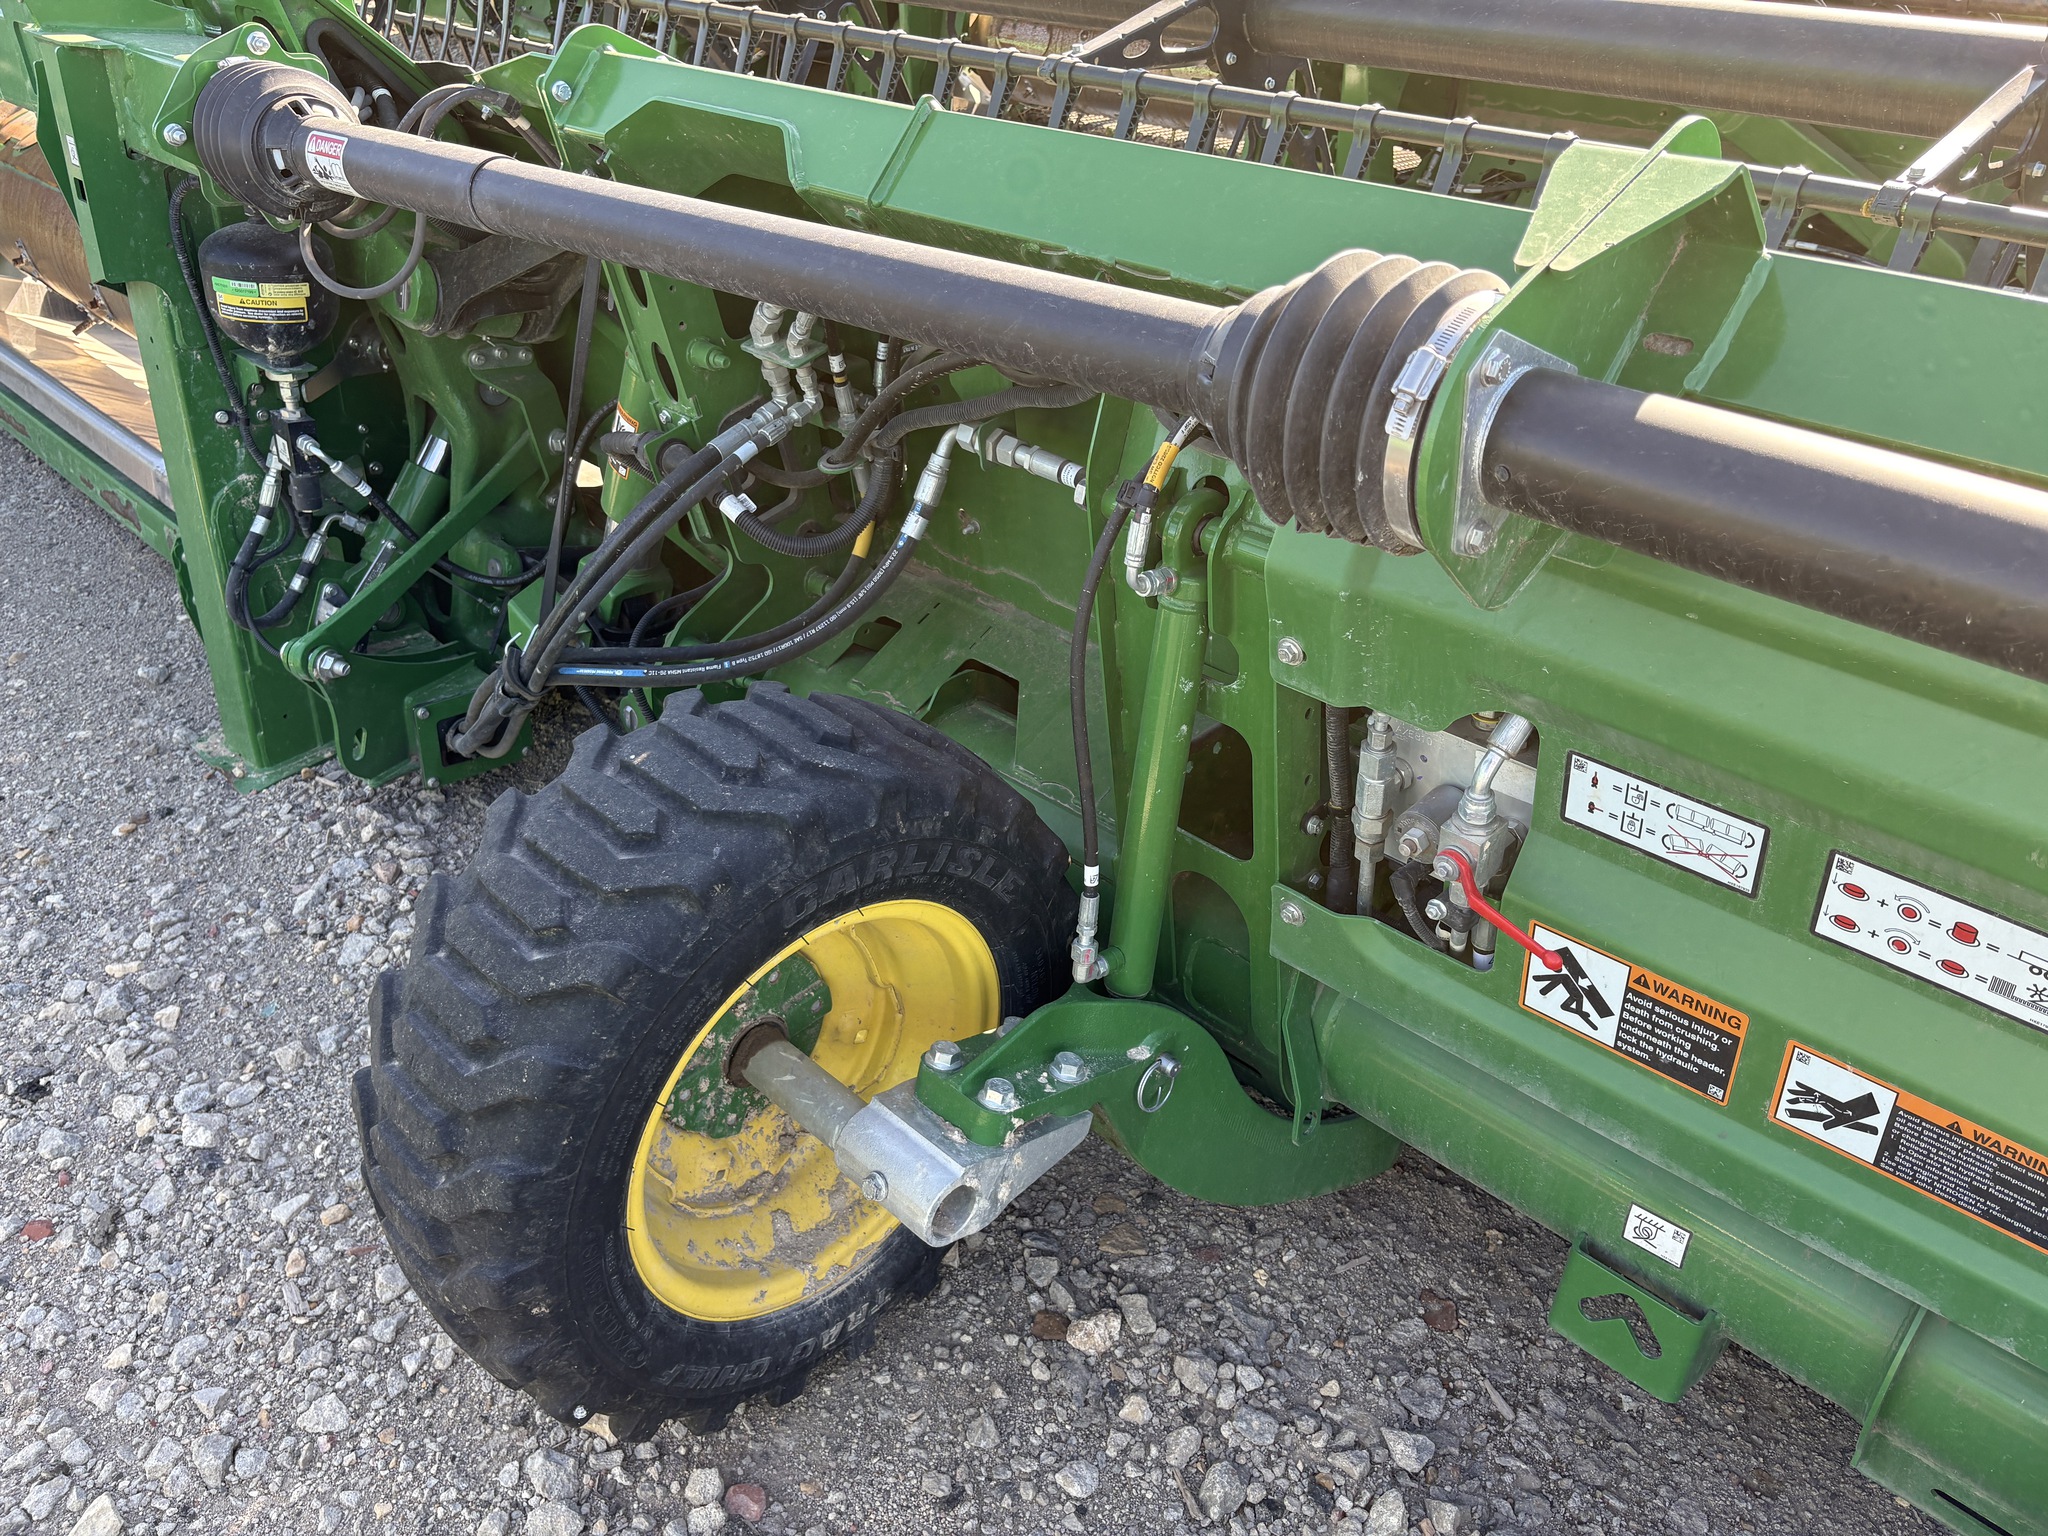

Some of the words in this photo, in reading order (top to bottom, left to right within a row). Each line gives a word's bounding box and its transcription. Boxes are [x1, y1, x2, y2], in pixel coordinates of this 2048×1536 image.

[316, 139, 343, 157] DANGER
[784, 842, 1025, 928] CARLISLE
[1622, 1011, 1652, 1031] Before
[1654, 1025, 1692, 1050] working
[1624, 1002, 1650, 1019] death
[1652, 1015, 1673, 1030] from
[1675, 1026, 1720, 1052] crushing.
[1626, 992, 1652, 1009] Avoid
[1654, 1004, 1689, 1027] serious
[1691, 1021, 1720, 1041] injury
[1721, 1036, 1732, 1046] or
[1652, 980, 1742, 1030] WARNING
[1616, 1040, 1651, 1061] system.
[1618, 1030, 1638, 1044] lock
[1640, 1040, 1654, 1052] the
[1656, 1048, 1699, 1074] hydraulic
[1620, 1022, 1672, 1050] underneath
[1674, 1046, 1689, 1058] the
[1691, 1053, 1726, 1077] header,
[1894, 1122, 1919, 1137] Before
[1920, 1135, 1956, 1156] removing
[1958, 1152, 1994, 1172] hydraulic
[1996, 1171, 2047, 1199] components.
[1896, 1116, 1906, 1124] oil
[1907, 1120, 1922, 1132] and
[1923, 1128, 1938, 1139] gas
[1939, 1136, 1962, 1150] under
[1963, 1148, 2000, 1168] pressure.
[1898, 1110, 1920, 1124] Avoid
[1922, 1122, 1950, 1138] serious
[1952, 1134, 1974, 1150] injury
[1976, 1146, 1994, 1159] from
[1996, 1156, 2026, 1174] contact
[2028, 1170, 2044, 1183] with
[1902, 1132, 1937, 1153] changing
[1880, 1162, 1894, 1172] See
[1895, 1170, 1912, 1181] your
[1914, 1180, 1933, 1192] John
[1934, 1188, 1957, 1202] Deere
[1958, 1200, 1983, 1216] dealer.
[1882, 1156, 1897, 1167] Use
[1898, 1165, 1914, 1176] only
[1916, 1173, 1933, 1183] DRY
[1934, 1182, 1976, 1205] NITROGEN
[1976, 1202, 1988, 1211] for
[1989, 1209, 2032, 1233] recharging
[1883, 1150, 1890, 1158] 2.
[1894, 1156, 1912, 1168] Stop
[1913, 1166, 1939, 1180] engine
[1940, 1179, 1956, 1188] and
[1956, 1186, 1985, 1203] remove
[1986, 1200, 2002, 1211] key.
[1896, 1151, 1924, 1166] system
[1925, 1164, 1970, 1190] information.
[1898, 1144, 1906, 1152] to
[1908, 1149, 1942, 1168] Operator
[1942, 1166, 1971, 1182] Manual
[1972, 1180, 1988, 1190] and
[1988, 1187, 2014, 1204] Repair
[2016, 1200, 2046, 1218] Manual
[1900, 1138, 1928, 1155] Relieve
[1930, 1153, 1957, 1169] system
[1958, 1166, 1994, 1187] hydraulic
[1996, 1185, 2038, 1208] pressures.
[790, 1287, 894, 1364] TRAC
[655, 1356, 773, 1391] CHIEF
